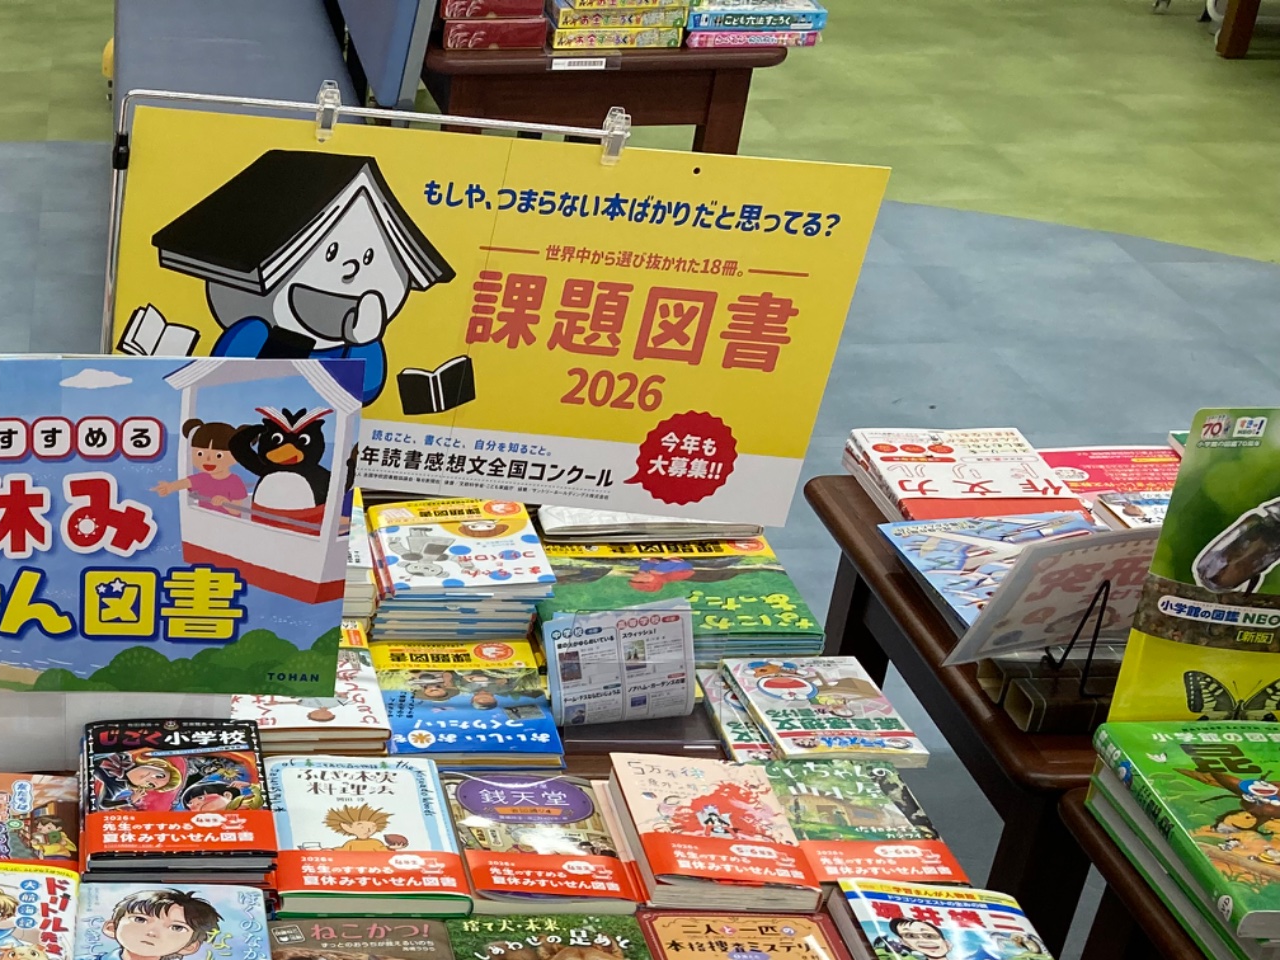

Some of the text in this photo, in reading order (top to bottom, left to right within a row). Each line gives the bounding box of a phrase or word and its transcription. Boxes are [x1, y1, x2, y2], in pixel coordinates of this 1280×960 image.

[725, 15, 791, 26] こども六法すごろく
[423, 180, 841, 237] もしや、つまらない本ばかりだと思ってる?
[545, 243, 748, 278] 世界中から選び抜かれた18冊。
[465, 270, 800, 373] 課題図書
[561, 367, 664, 413] 2026
[660, 429, 718, 457] 今年も
[648, 452, 724, 482] 大募集!!
[886, 463, 1039, 479] ドリル
[897, 478, 1063, 496] 作文力
[419, 508, 480, 517] 課題図書
[607, 541, 724, 553] 課題図書
[685, 590, 797, 611] あった!
[1159, 599, 1280, 626] 小学館の図鑑 NEO
[1235, 630, 1274, 645] [新版]
[389, 653, 471, 663] 課題図書
[268, 672, 320, 682] TOHAN
[765, 708, 827, 717] が書ける
[413, 718, 524, 729] つくりたい!
[772, 718, 905, 731] 読書感想文
[99, 729, 253, 747] じごく小学校
[766, 764, 893, 779] じいちゃんの
[307, 783, 395, 795] 料理法
[789, 782, 882, 798] 山小屋
[479, 789, 570, 806] 銭天堂
[102, 831, 255, 843] 夏休みすいせん図書
[300, 864, 395, 875] 先生のすすめる
[302, 875, 458, 889] 夏休みすいせん図書
[891, 885, 978, 900] 学習まんが人物館
[16, 879, 40, 928] 大航海記
[40, 877, 70, 956] ドリトル先生
[871, 901, 1025, 931] 堀井雄二
[310, 923, 430, 940] ねこかつ!
[462, 920, 567, 932] 捨て犬・未来、
[681, 924, 797, 937] 二人と一匹の
[474, 931, 631, 960] しあわせの足あと
[666, 940, 827, 953] 本格捜査ミステリー
